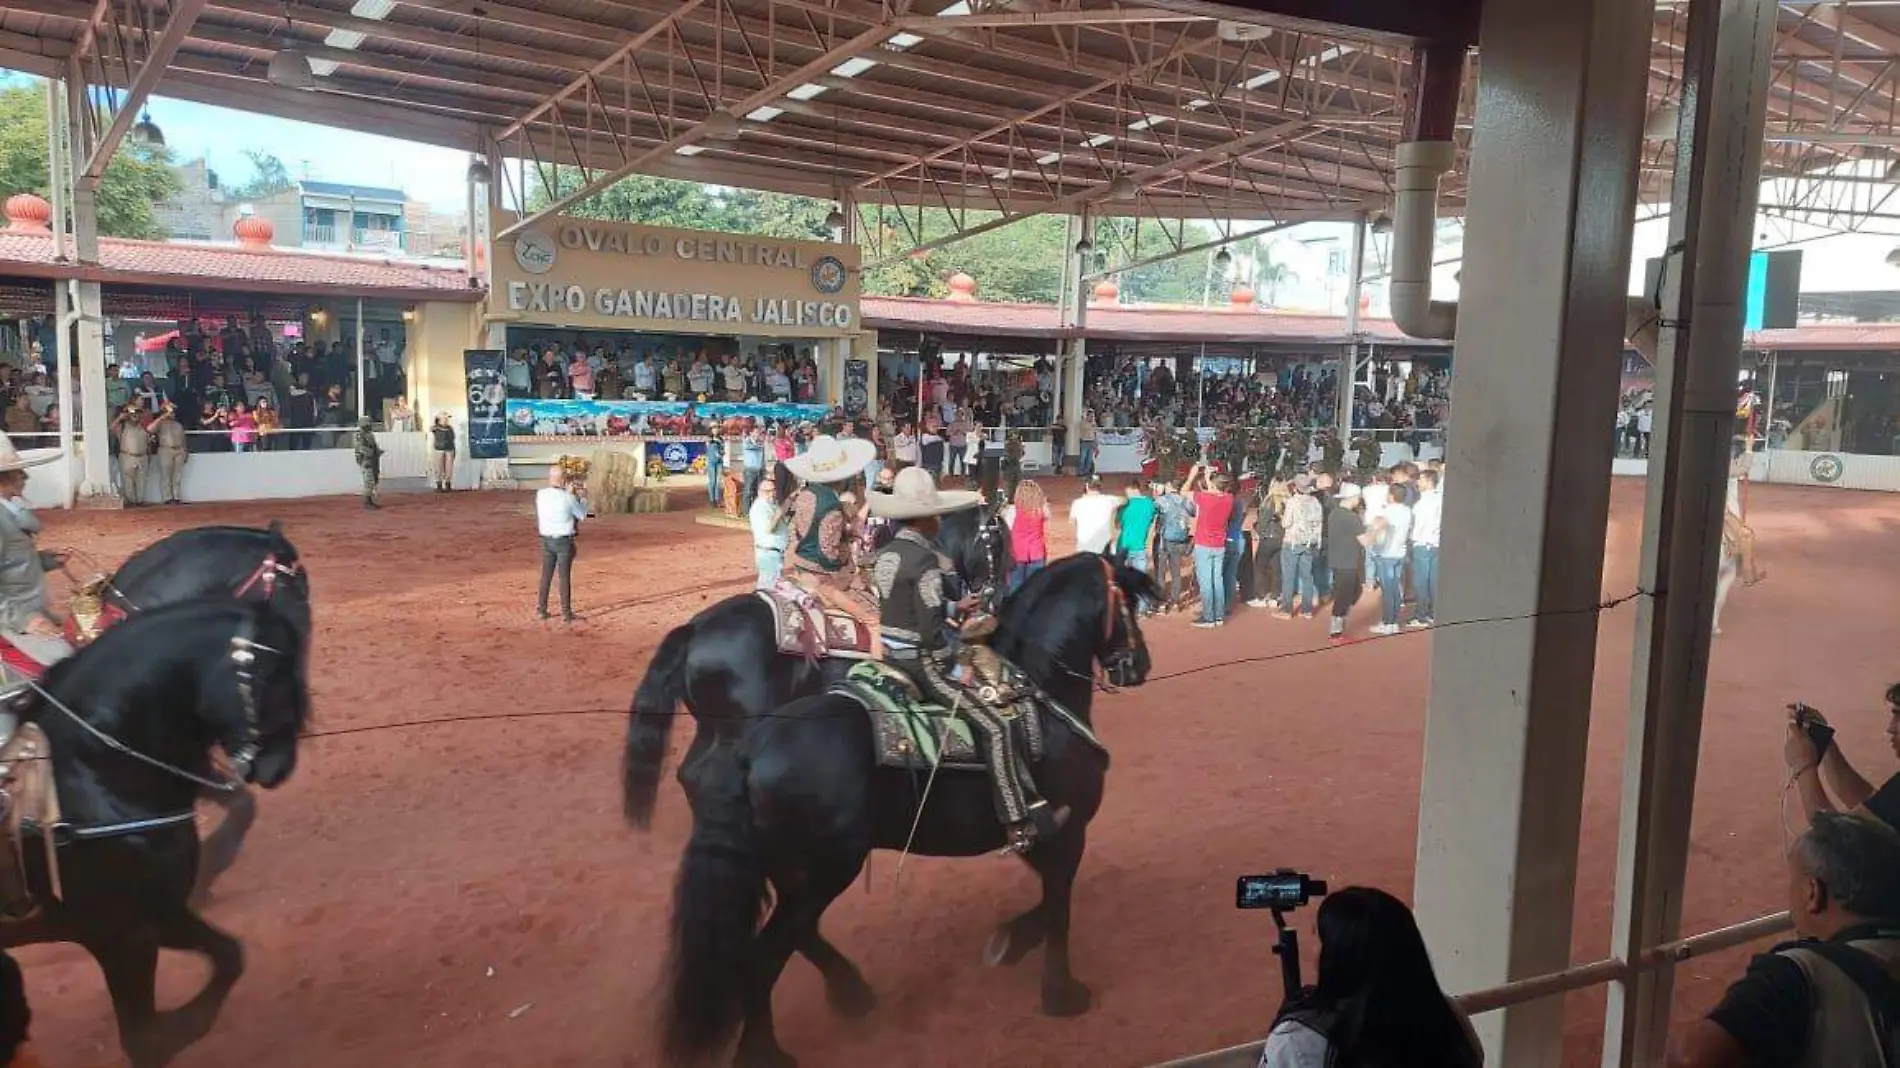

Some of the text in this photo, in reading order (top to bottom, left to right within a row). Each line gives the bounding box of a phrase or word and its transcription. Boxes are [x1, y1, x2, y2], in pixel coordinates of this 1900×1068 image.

[560, 226, 665, 256] OVALO
[676, 237, 808, 269] CENTRAL
[508, 281, 851, 329] EXPO GANADERA JALISCO
